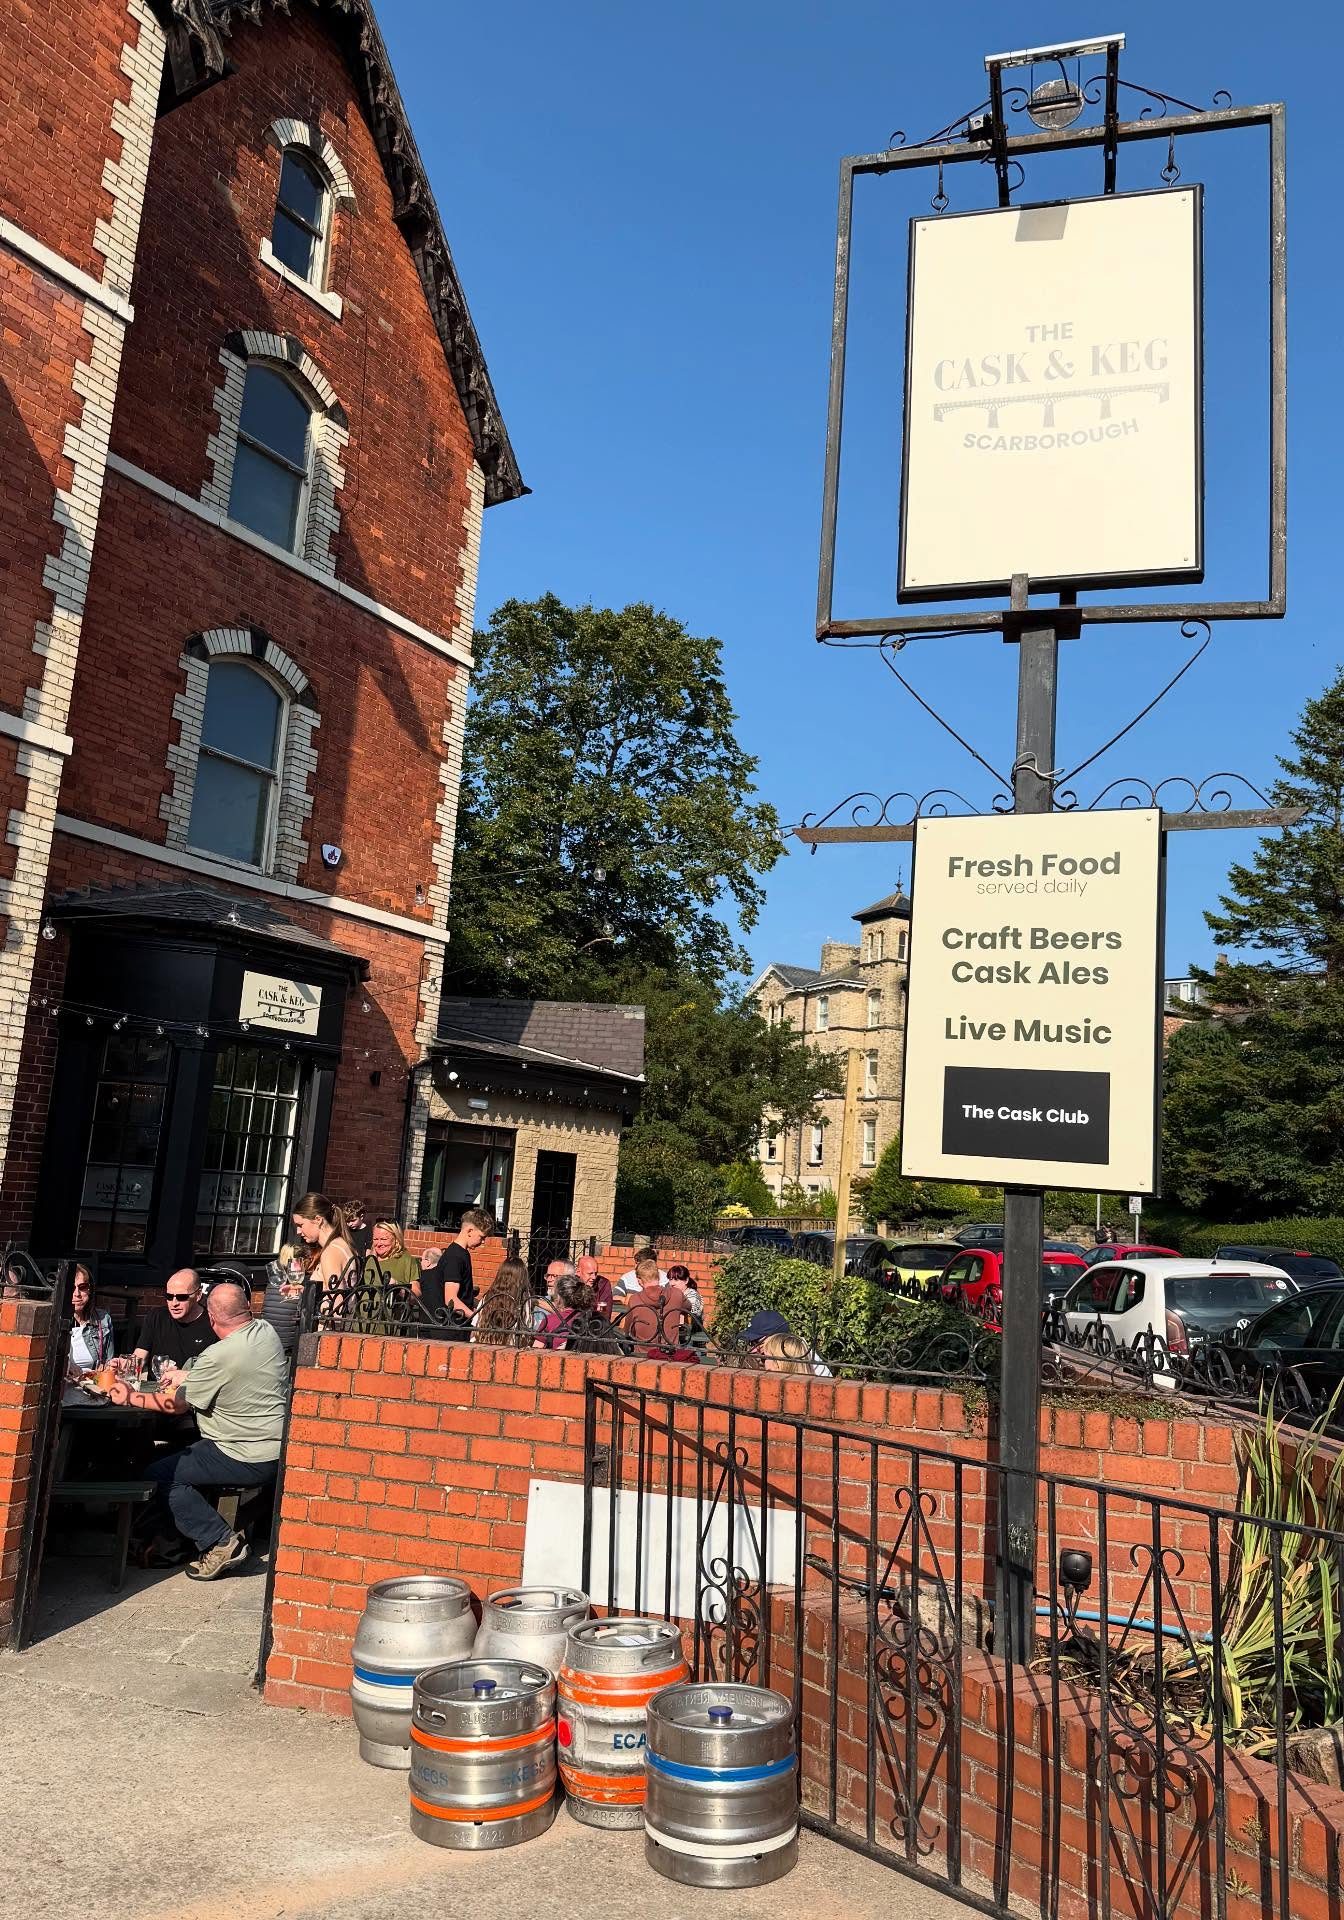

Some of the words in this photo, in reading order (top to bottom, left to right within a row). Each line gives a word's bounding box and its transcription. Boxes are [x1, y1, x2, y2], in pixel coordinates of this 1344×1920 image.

[1025, 322, 1073, 343] THE
[934, 352, 1031, 392] CASK
[1043, 348, 1076, 381] &
[1091, 337, 1169, 377] KEG
[962, 417, 1140, 451] SCARBOROUGH
[948, 854, 1033, 878] Fresh
[1041, 851, 1121, 876] Food
[976, 879, 1038, 895] served
[1043, 878, 1088, 897] daily
[942, 926, 1022, 950] Craft
[1030, 927, 1122, 950] Beers
[951, 961, 1031, 984] Cask
[1038, 961, 1109, 985] Ales
[258, 988, 279, 1002] CASK
[278, 985, 288, 993] THE
[945, 1015, 1006, 1041] Live
[1013, 1018, 1112, 1044] Music
[962, 1104, 994, 1120] The
[997, 1106, 1043, 1123] Cask
[1046, 1108, 1089, 1125] Club
